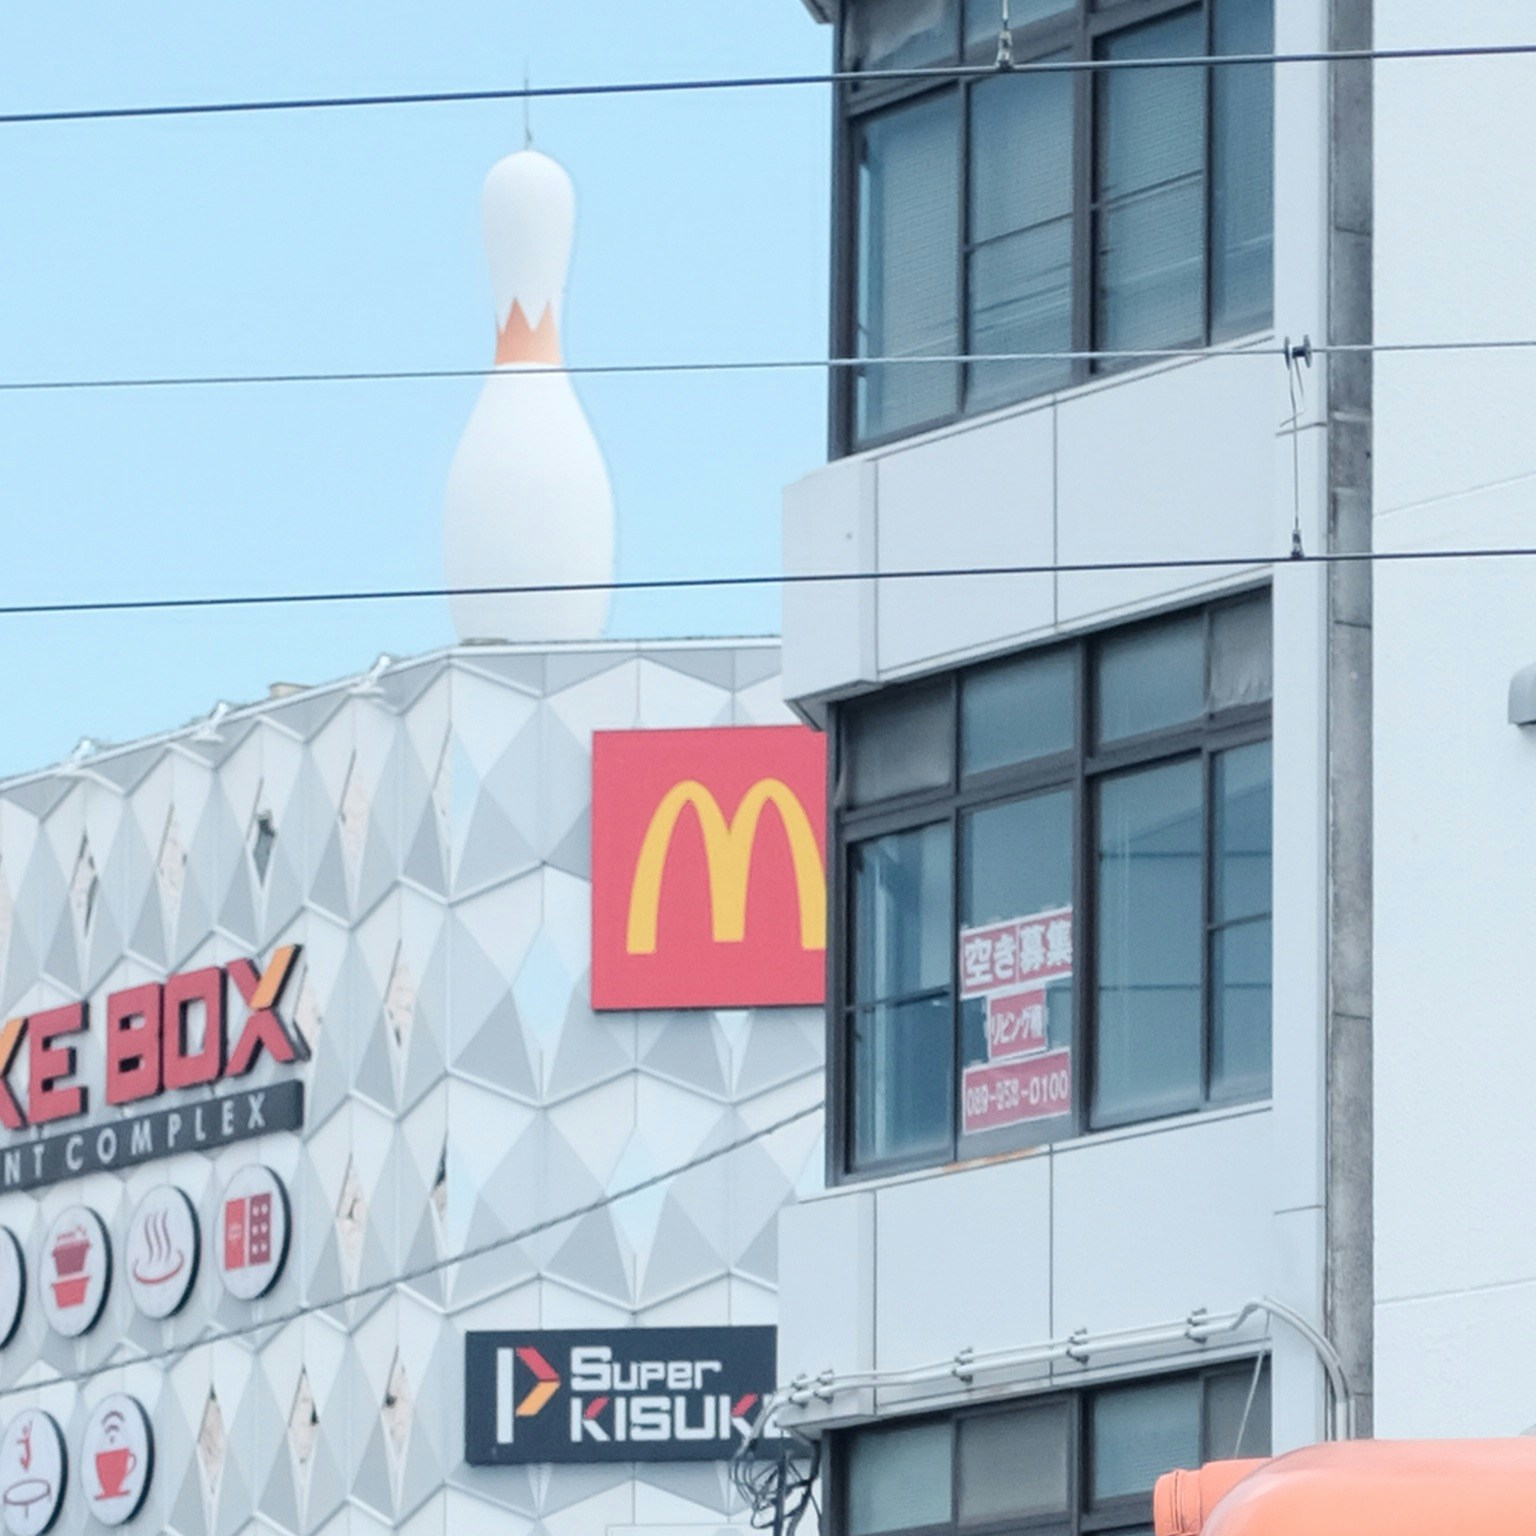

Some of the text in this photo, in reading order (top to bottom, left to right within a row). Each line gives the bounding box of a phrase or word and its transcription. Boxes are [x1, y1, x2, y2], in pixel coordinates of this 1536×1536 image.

[105, 944, 308, 1106] BOX
[65, 1093, 266, 1170] COMPLEX
[570, 1346, 722, 1391] Super
